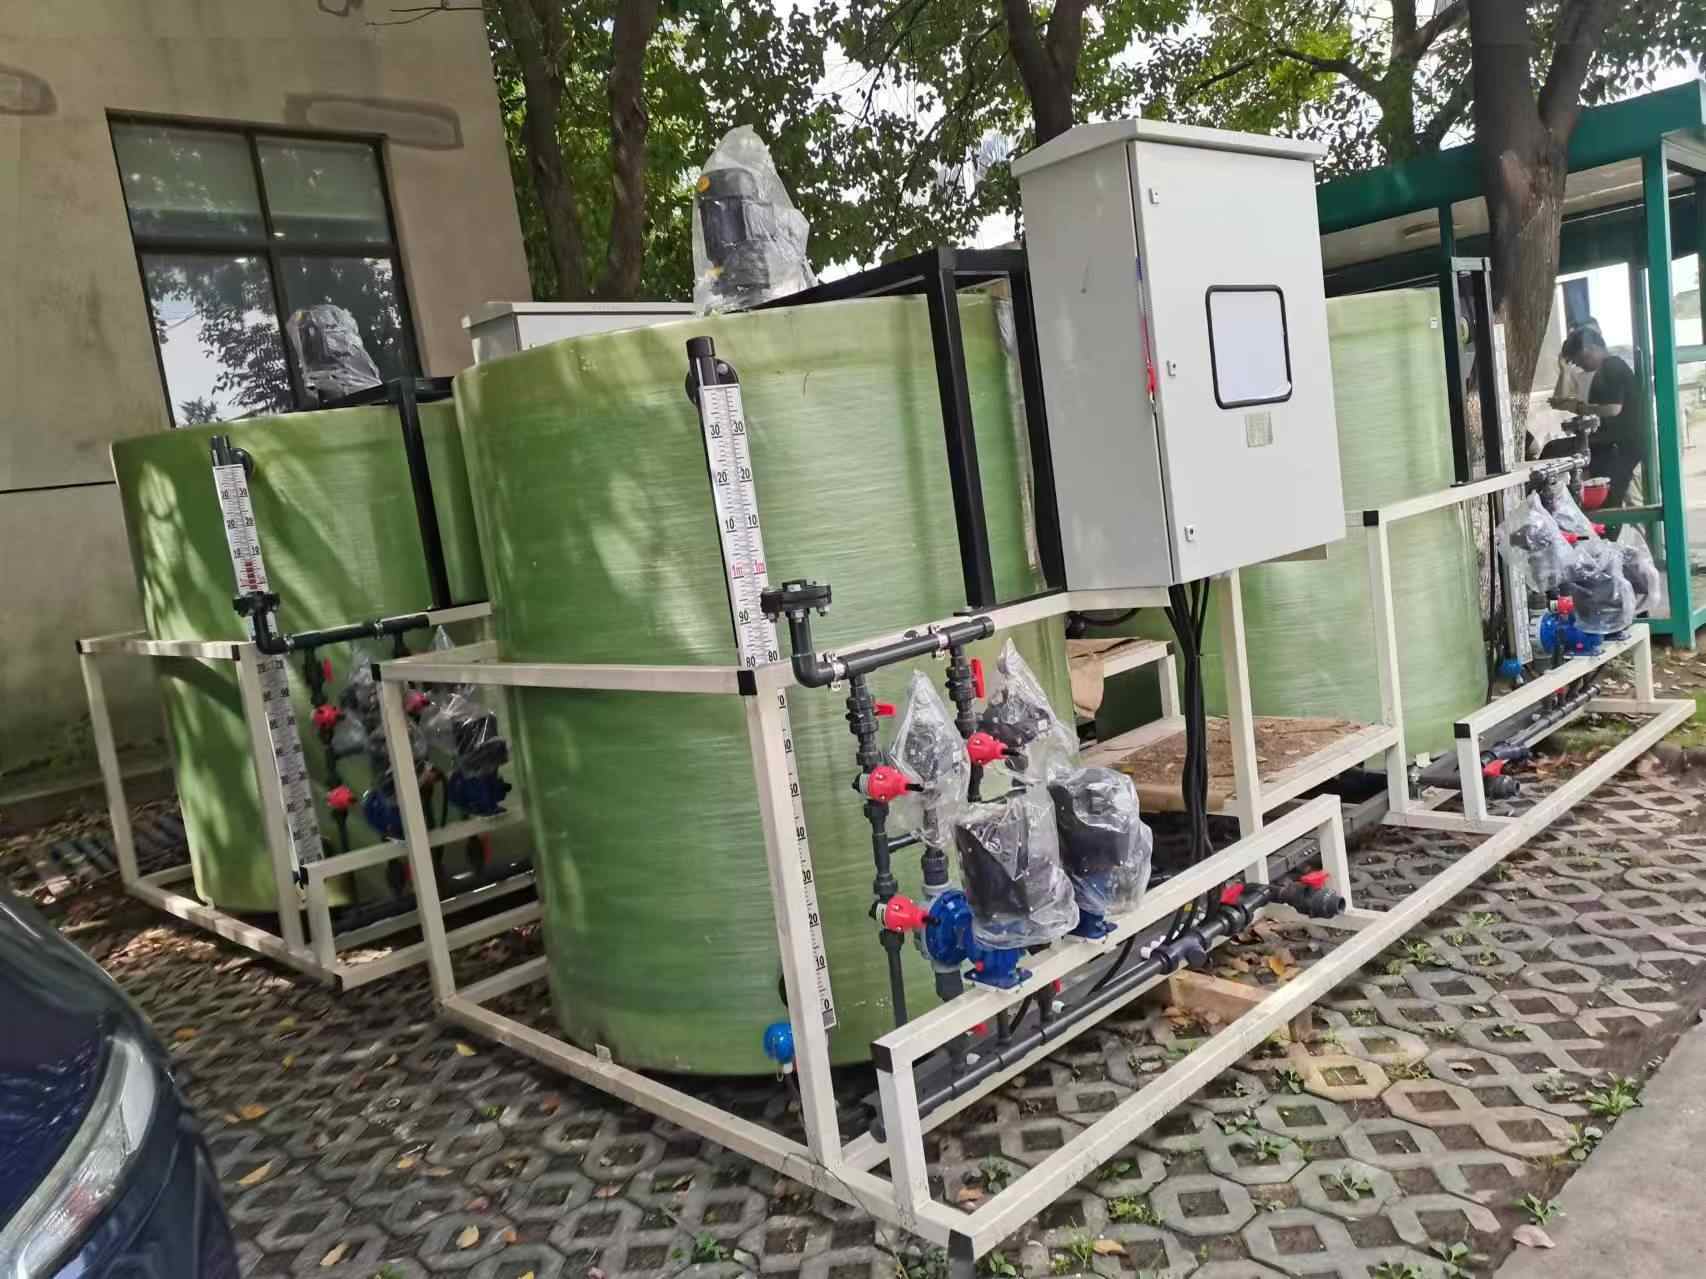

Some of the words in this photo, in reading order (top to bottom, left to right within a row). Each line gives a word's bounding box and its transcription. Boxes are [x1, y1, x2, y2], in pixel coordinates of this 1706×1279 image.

[709, 424, 720, 436] 30
[734, 421, 744, 433] 30
[717, 471, 728, 483] 20
[740, 467, 751, 479] 20
[725, 518, 735, 530] 10
[747, 514, 757, 526] 10
[732, 564, 743, 576] 1m
[753, 560, 766, 572] 1m
[738, 610, 749, 622] 90
[746, 656, 756, 668] 80
[768, 650, 778, 662] 80
[777, 694, 785, 706] 0
[784, 738, 792, 750] 0
[808, 912, 818, 925] 20
[815, 955, 825, 967] 10
[824, 998, 830, 1010] 0
